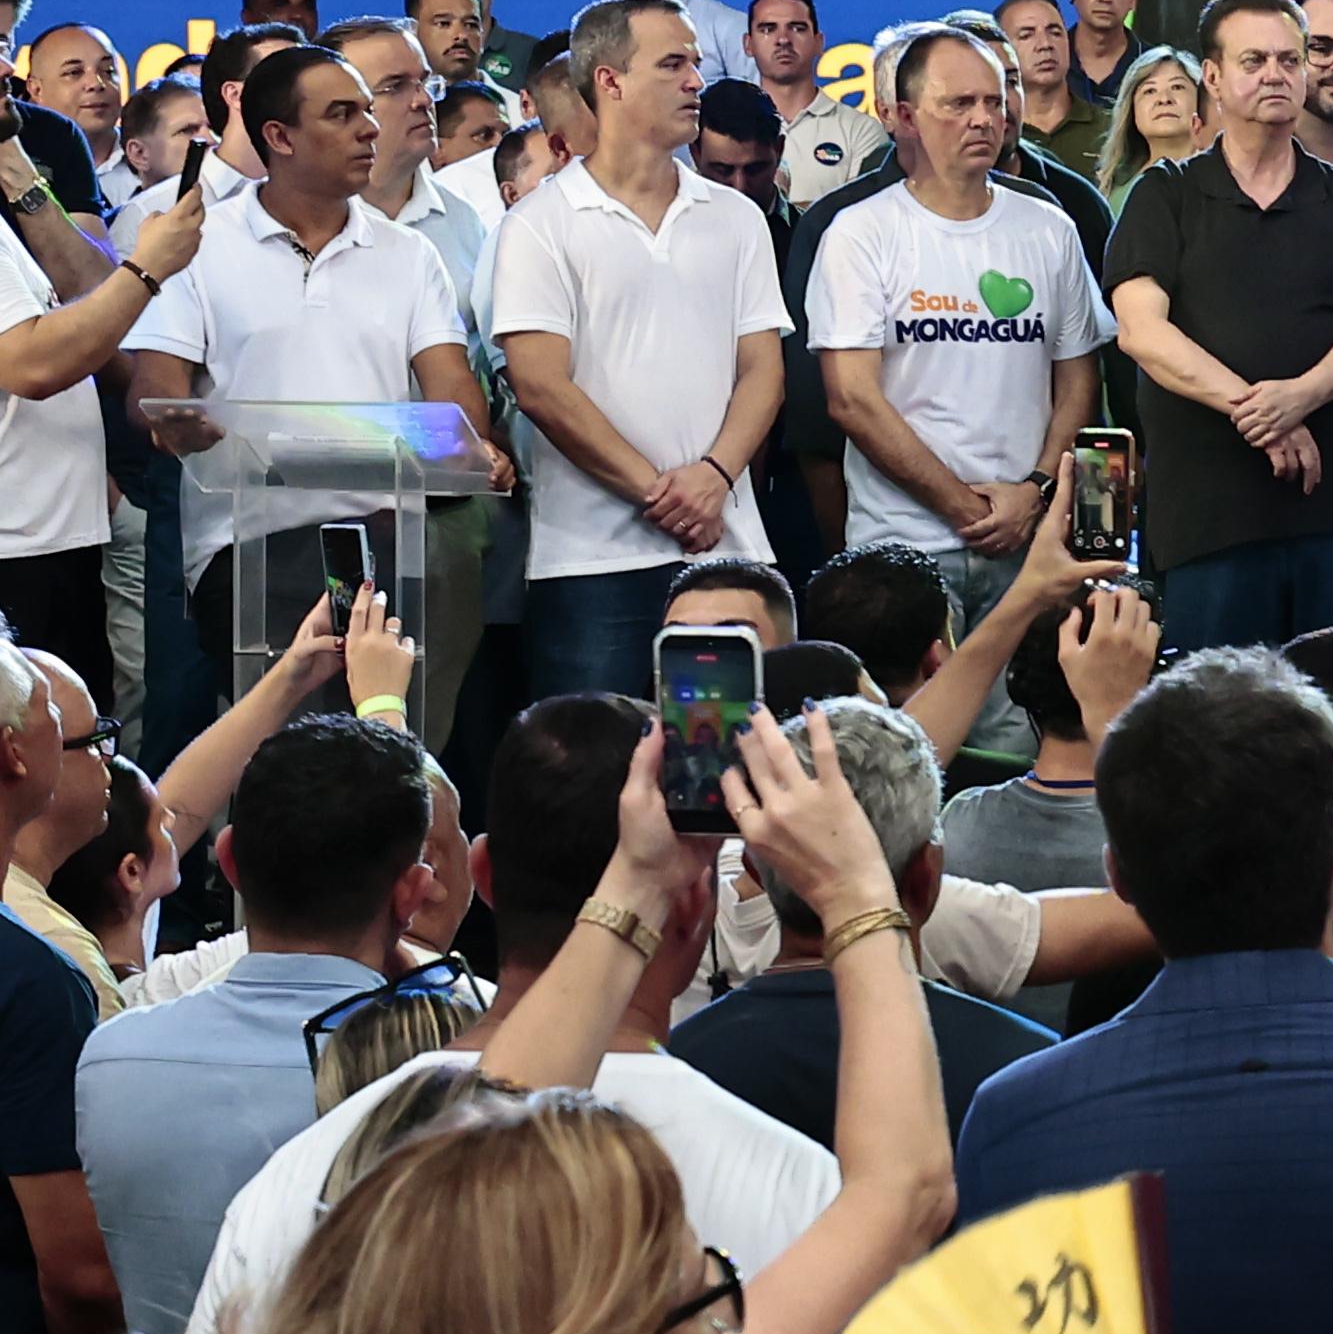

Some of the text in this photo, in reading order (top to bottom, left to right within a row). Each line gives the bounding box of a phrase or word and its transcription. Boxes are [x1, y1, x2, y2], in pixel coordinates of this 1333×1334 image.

[910, 289, 979, 313] Sou de
[895, 312, 1046, 344] MONGAGUÁ
